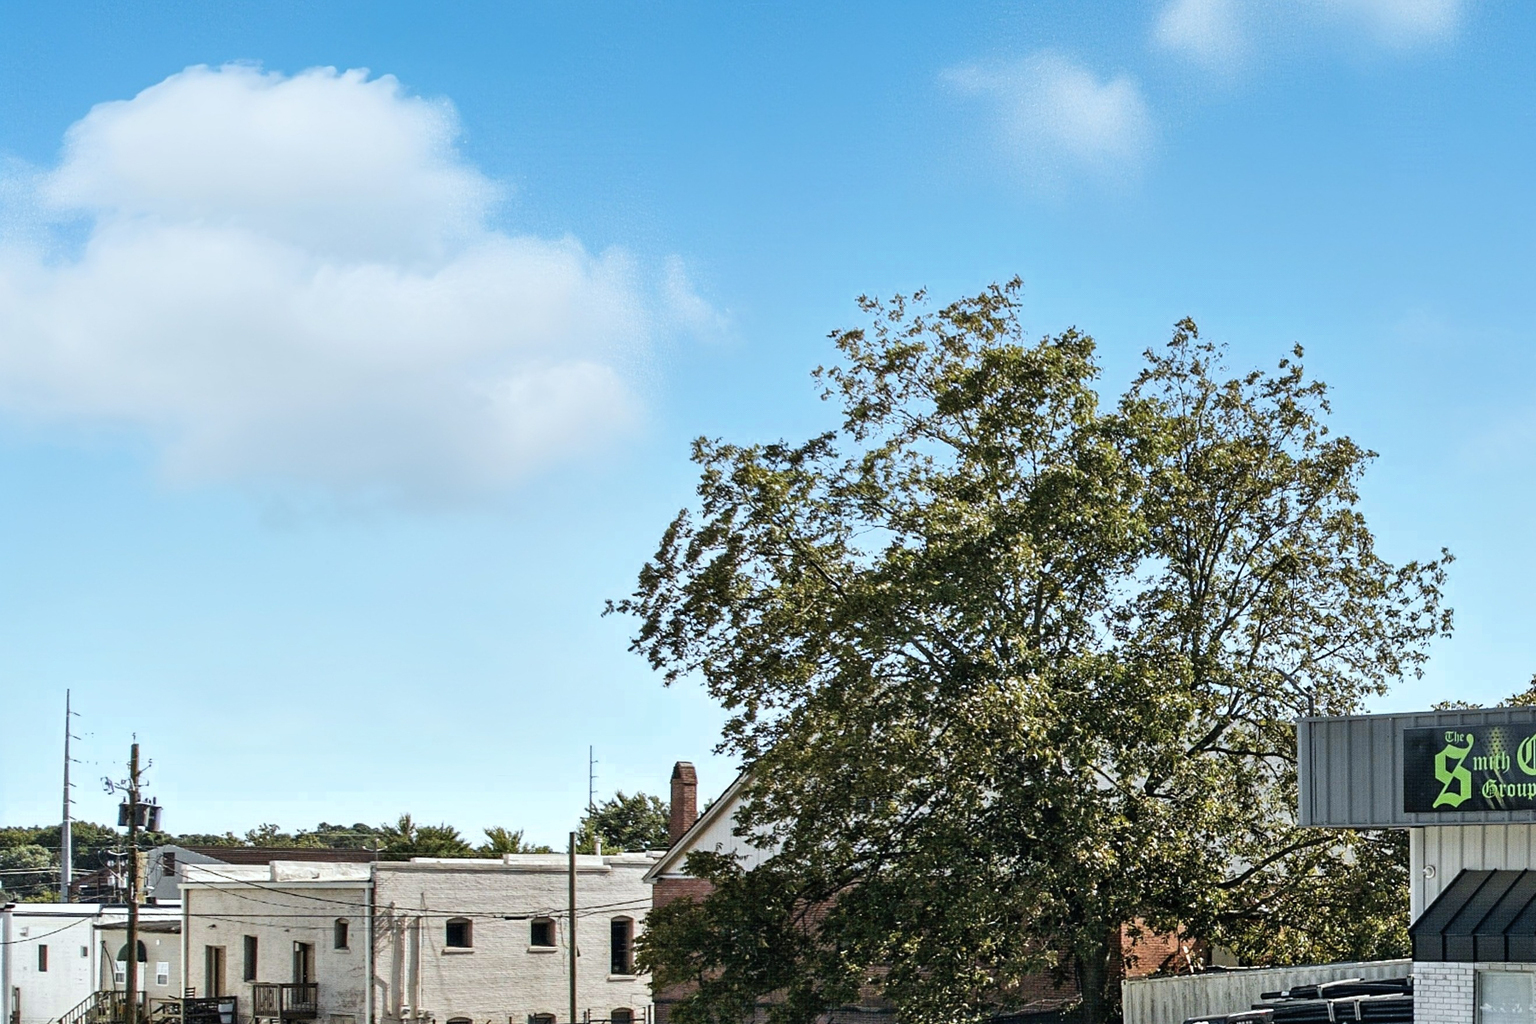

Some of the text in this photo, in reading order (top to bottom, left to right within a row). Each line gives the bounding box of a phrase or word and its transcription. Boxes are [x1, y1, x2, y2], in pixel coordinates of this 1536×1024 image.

[1445, 731, 1465, 744] The
[1432, 734, 1510, 809] Smith
[1482, 779, 1536, 800] Group
